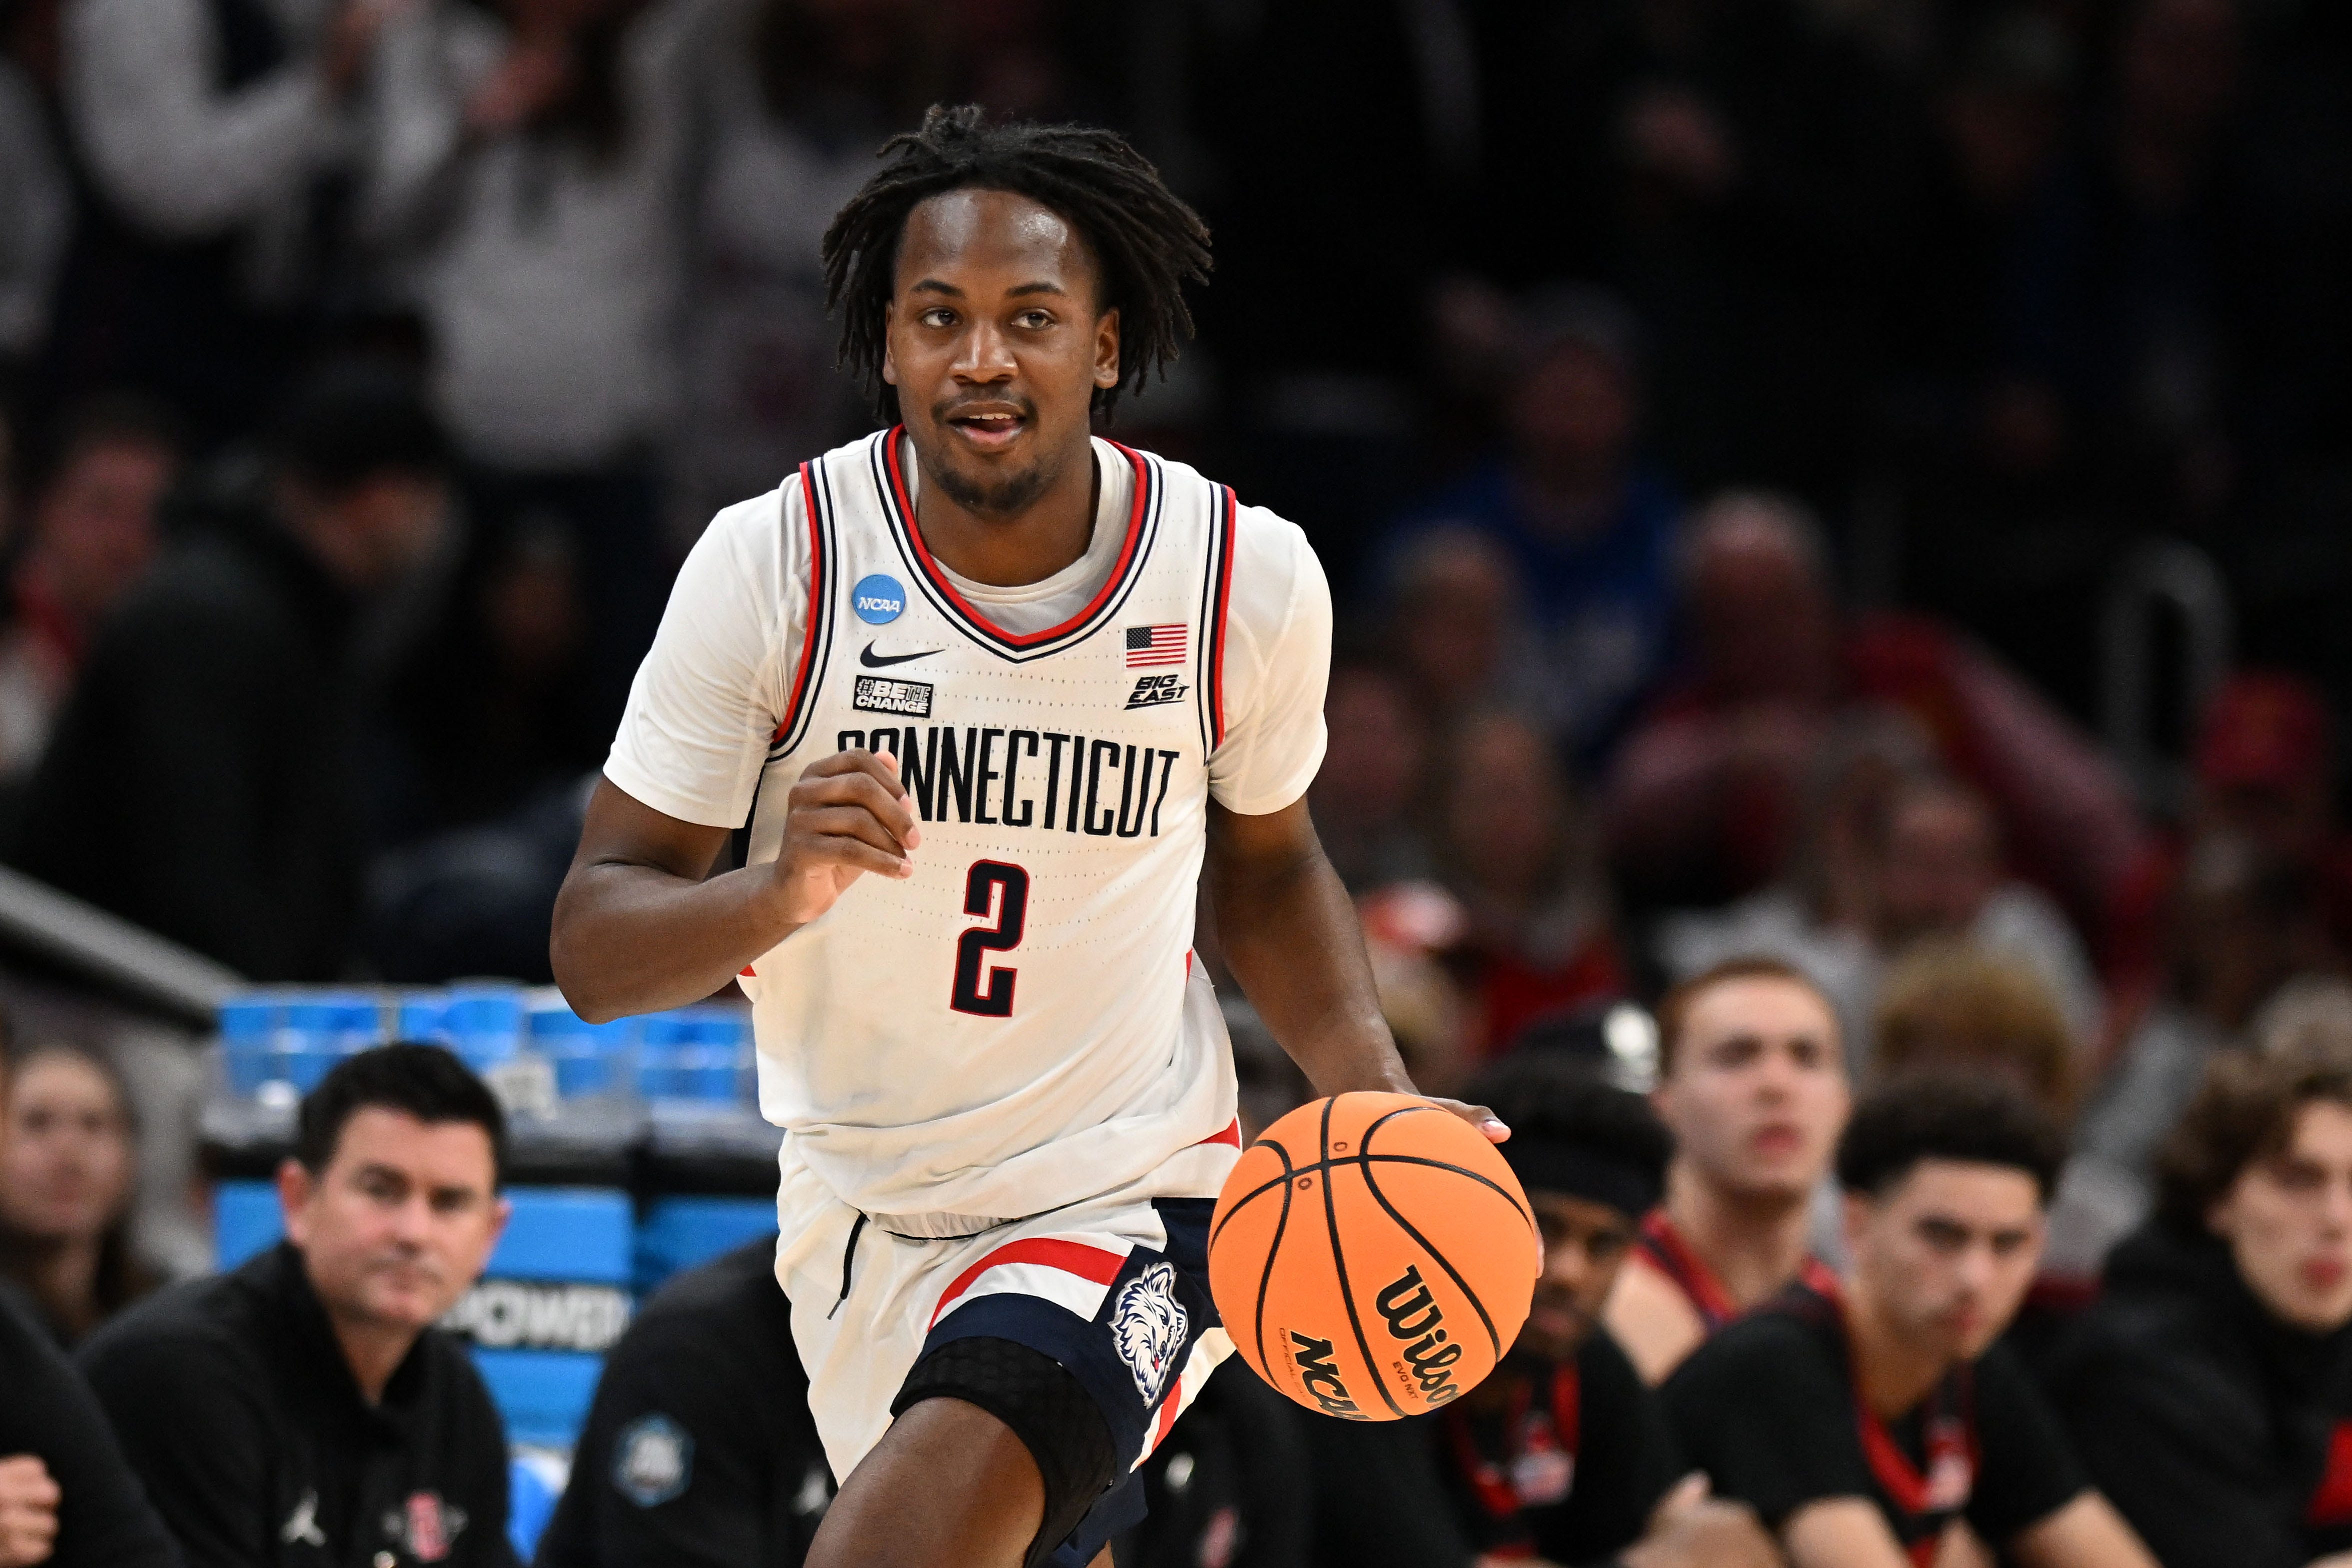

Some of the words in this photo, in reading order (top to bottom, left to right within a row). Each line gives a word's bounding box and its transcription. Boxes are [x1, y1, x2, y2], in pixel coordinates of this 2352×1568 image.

[858, 596, 900, 613] NCAA
[1127, 685, 1190, 703] EAST
[1134, 674, 1179, 690] BIG
[855, 695, 929, 714] CHANGE
[838, 726, 1180, 838] NNECTICUT
[950, 859, 1030, 1017] 2
[1375, 1264, 1462, 1409] Wilso
[1392, 1361, 1409, 1382] EVO
[1405, 1384, 1419, 1399] NXT
